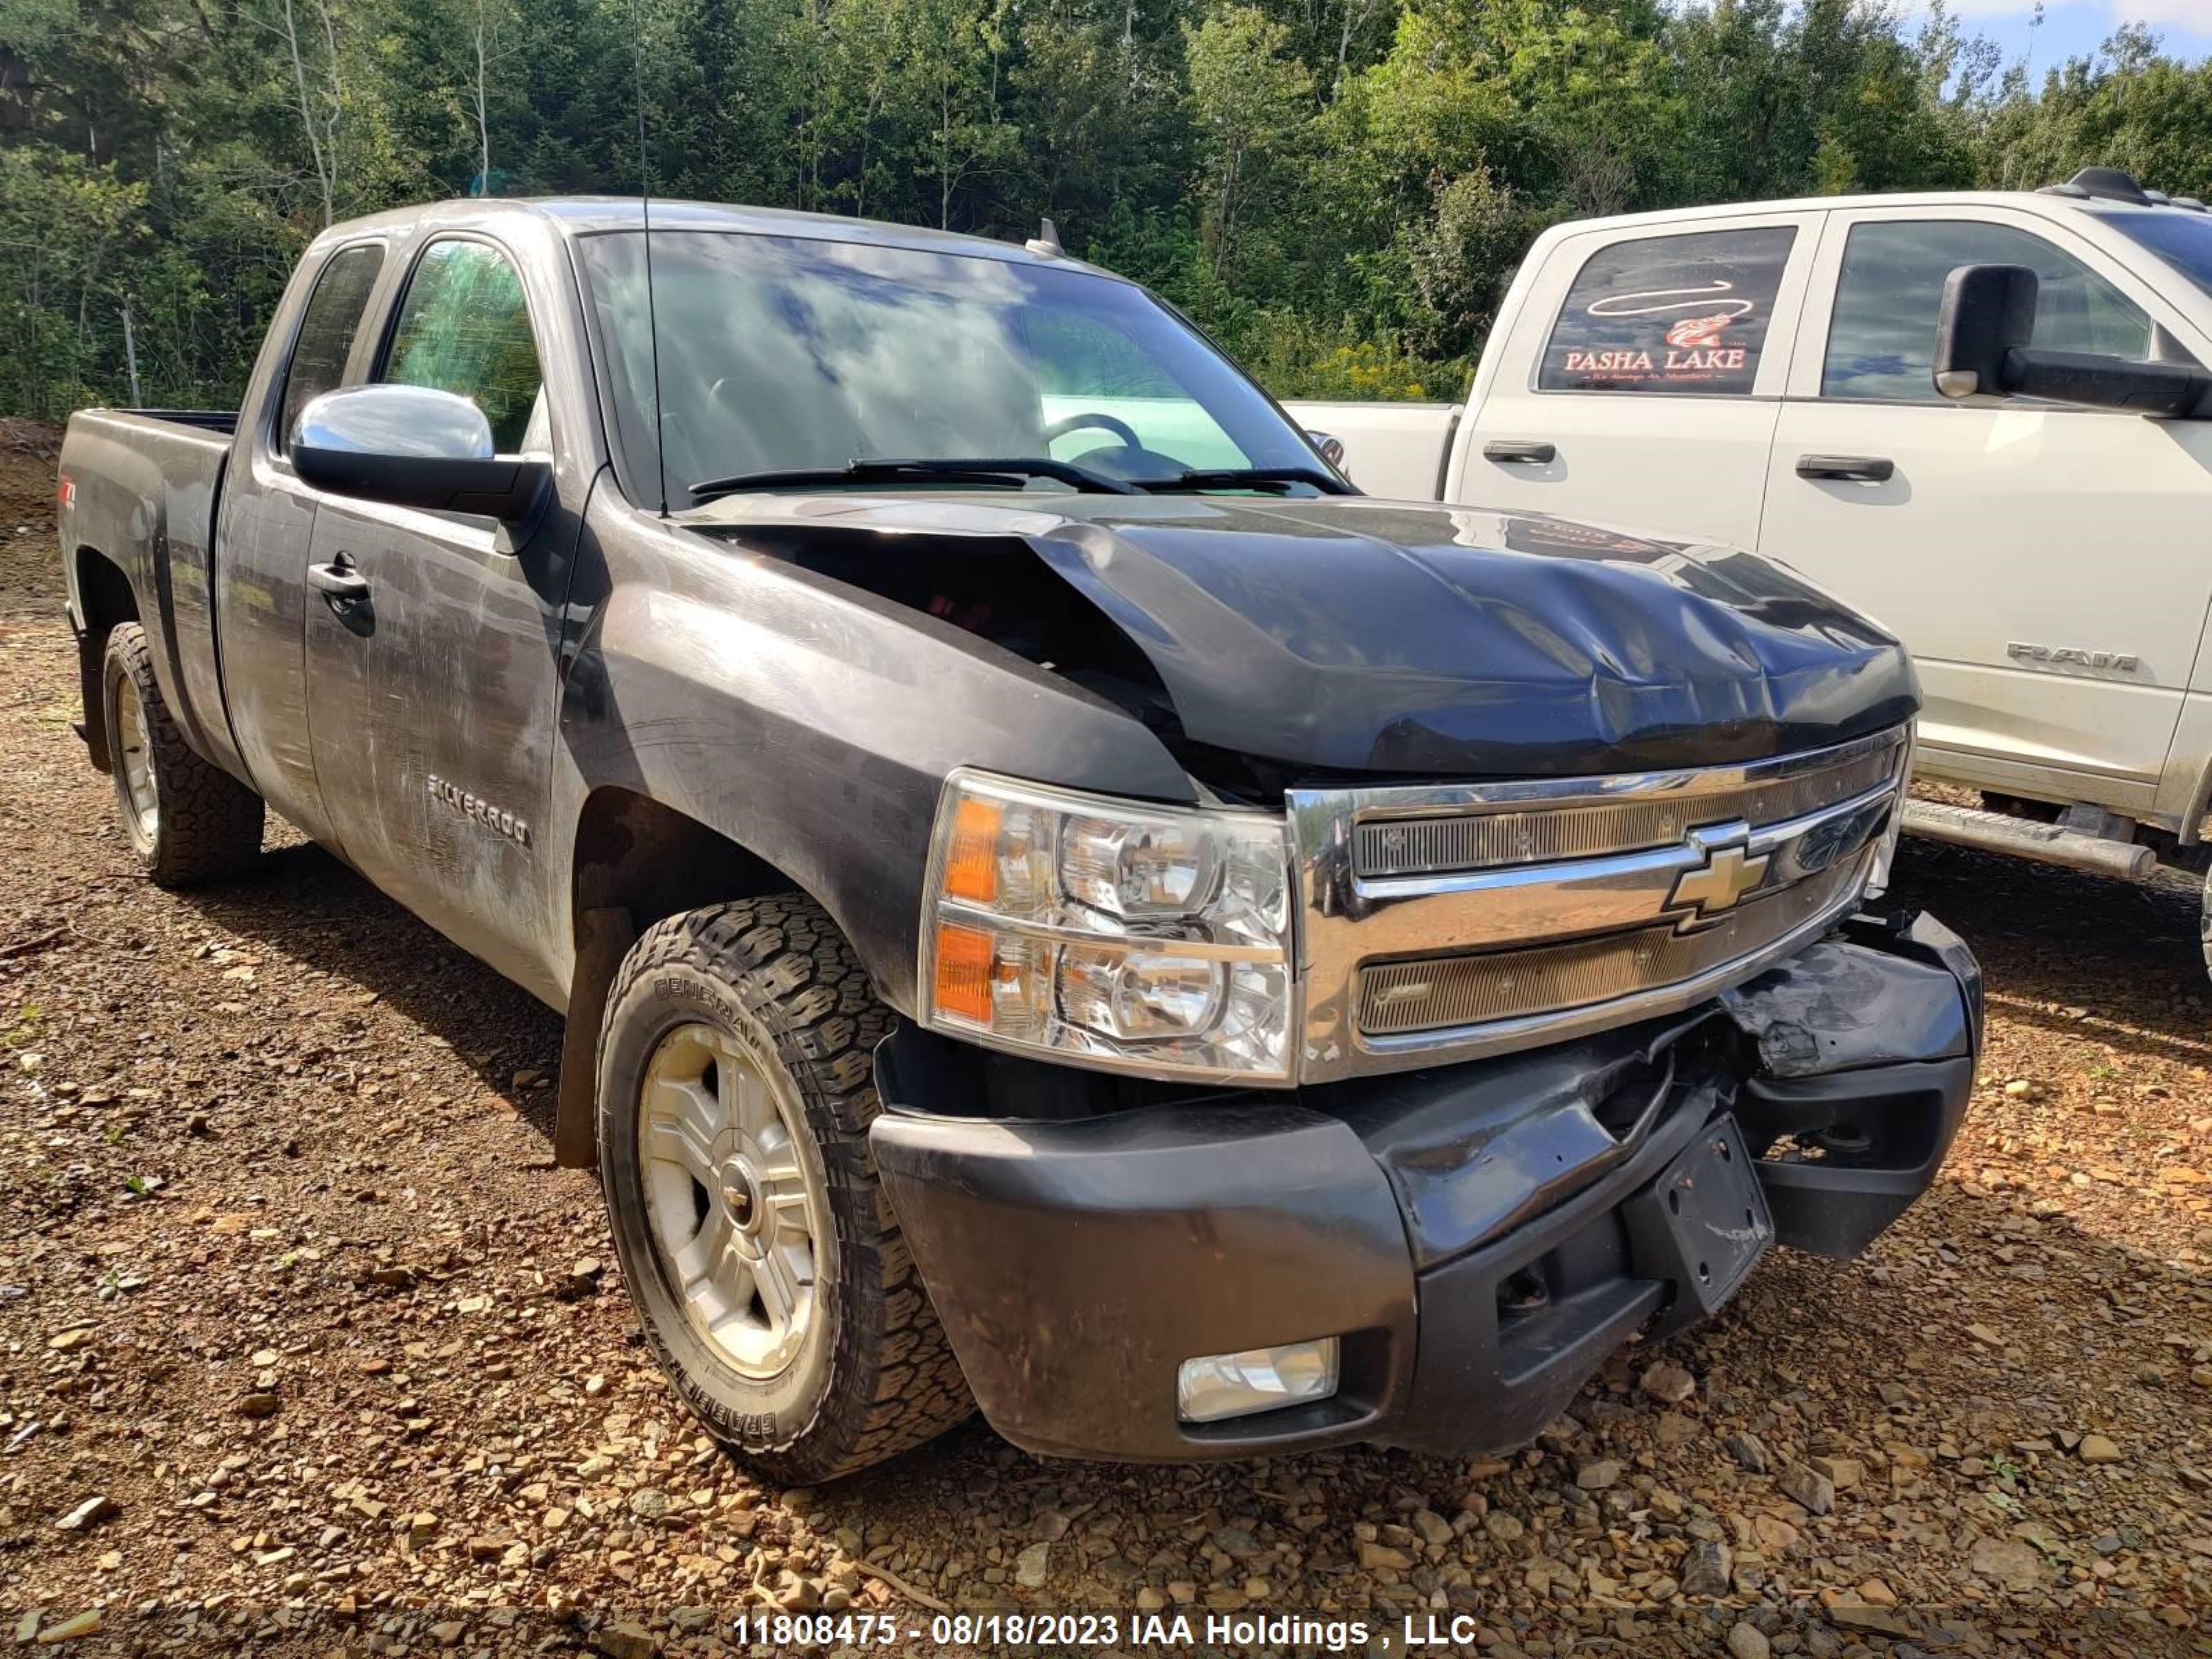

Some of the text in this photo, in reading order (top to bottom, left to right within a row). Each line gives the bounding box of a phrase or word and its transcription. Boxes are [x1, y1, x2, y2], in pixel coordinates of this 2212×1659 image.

[1564, 349, 1745, 371] PASHA LAKE
[2007, 642, 2138, 673] RAM
[429, 774, 529, 844] SILVERADO
[653, 976, 761, 1051] GENERAL
[668, 1358, 777, 1436] GRABBER
